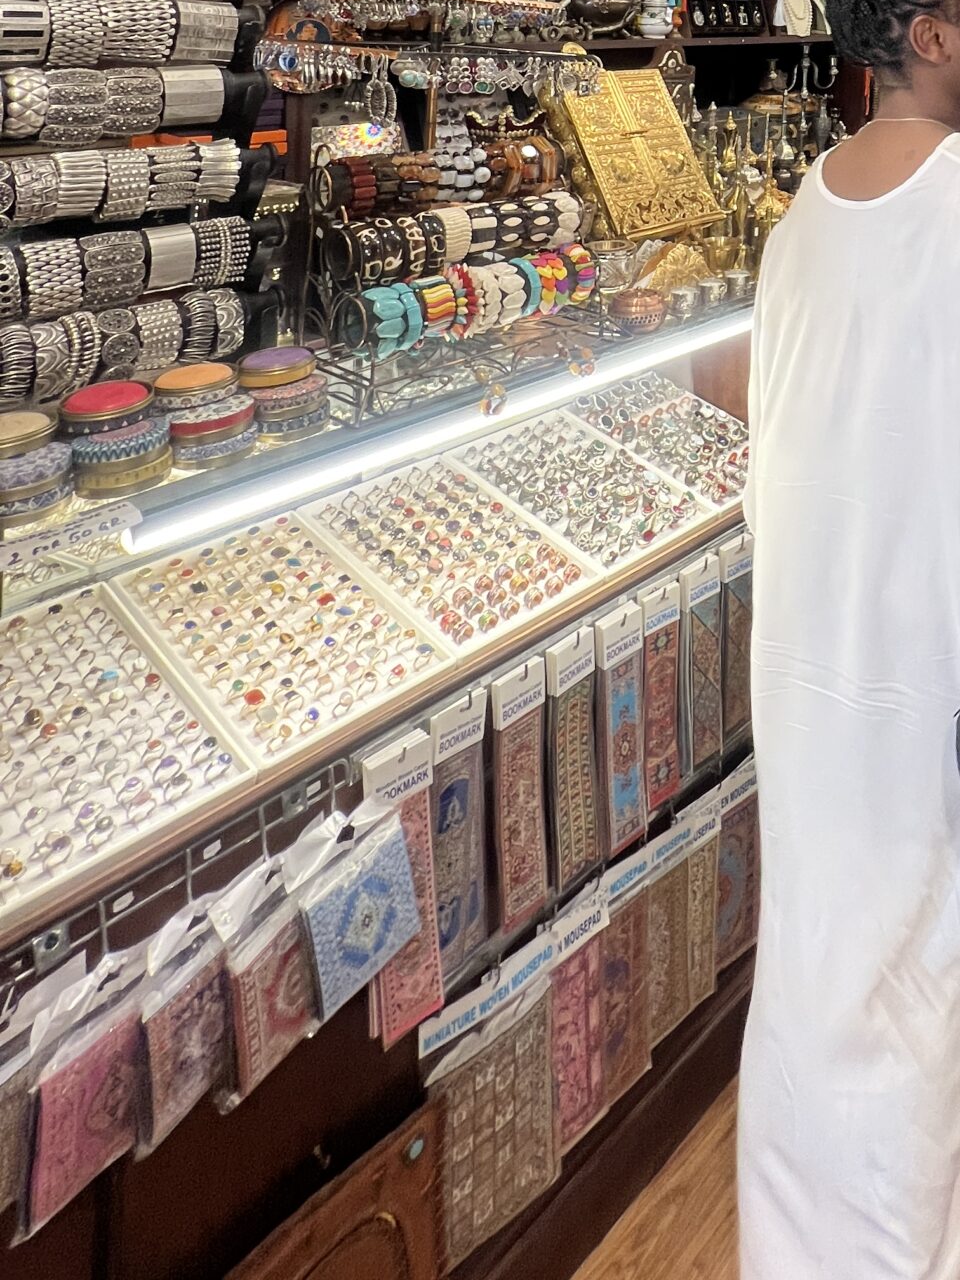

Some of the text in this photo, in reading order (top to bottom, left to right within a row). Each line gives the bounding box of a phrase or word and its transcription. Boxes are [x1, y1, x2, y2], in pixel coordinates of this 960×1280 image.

[7, 552, 23, 567] 2
[32, 539, 60, 556] FOR
[645, 606, 679, 633] BOOKMARK
[606, 632, 641, 662] BOOKMARK
[559, 655, 593, 688] BOOKMARK
[502, 687, 543, 722] BOOKMARK
[438, 721, 482, 755] BOOKMARK
[382, 766, 429, 800] OOKMARK
[656, 827, 692, 859] MOUSEPAD
[609, 860, 648, 895] MOUSEPAD
[563, 910, 602, 949] MOUSEPAD
[423, 944, 554, 1052] MINIATURE WOVEN MOUSEPAD
